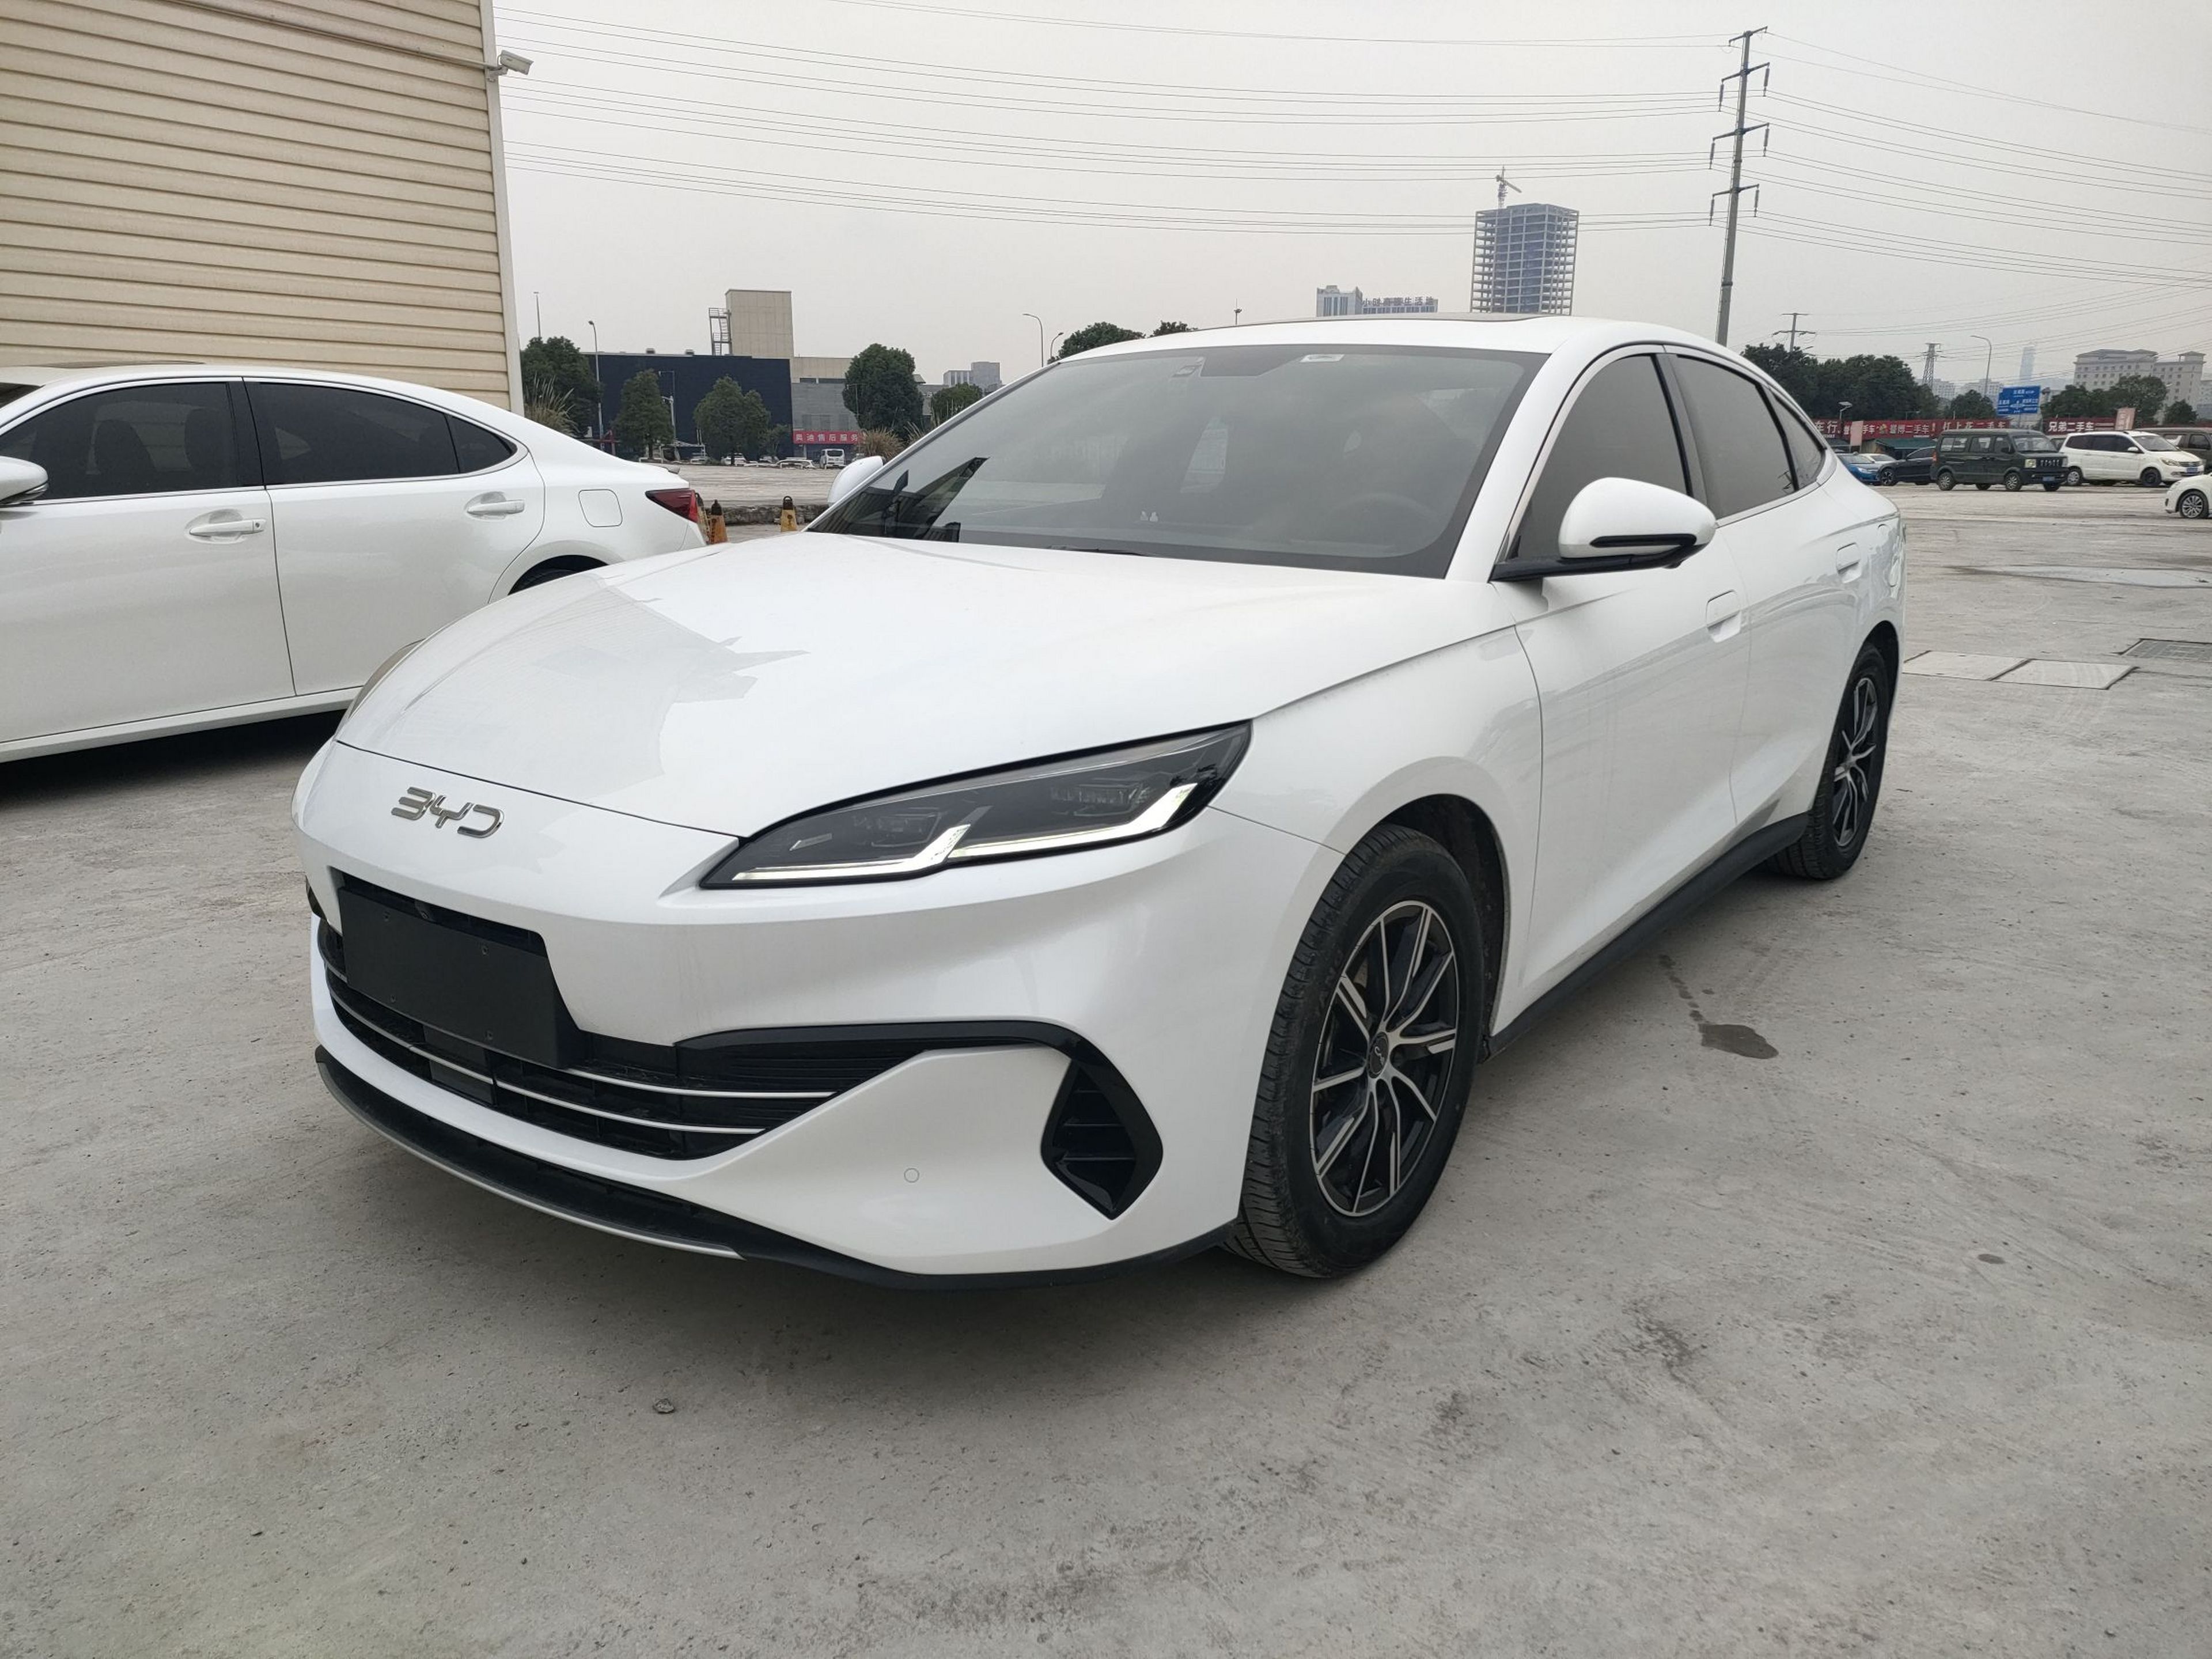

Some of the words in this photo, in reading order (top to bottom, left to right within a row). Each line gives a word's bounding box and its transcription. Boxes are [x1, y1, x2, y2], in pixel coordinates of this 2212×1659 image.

[2048, 421, 2094, 432] 兄弟二手车
[391, 786, 505, 839] BYD
